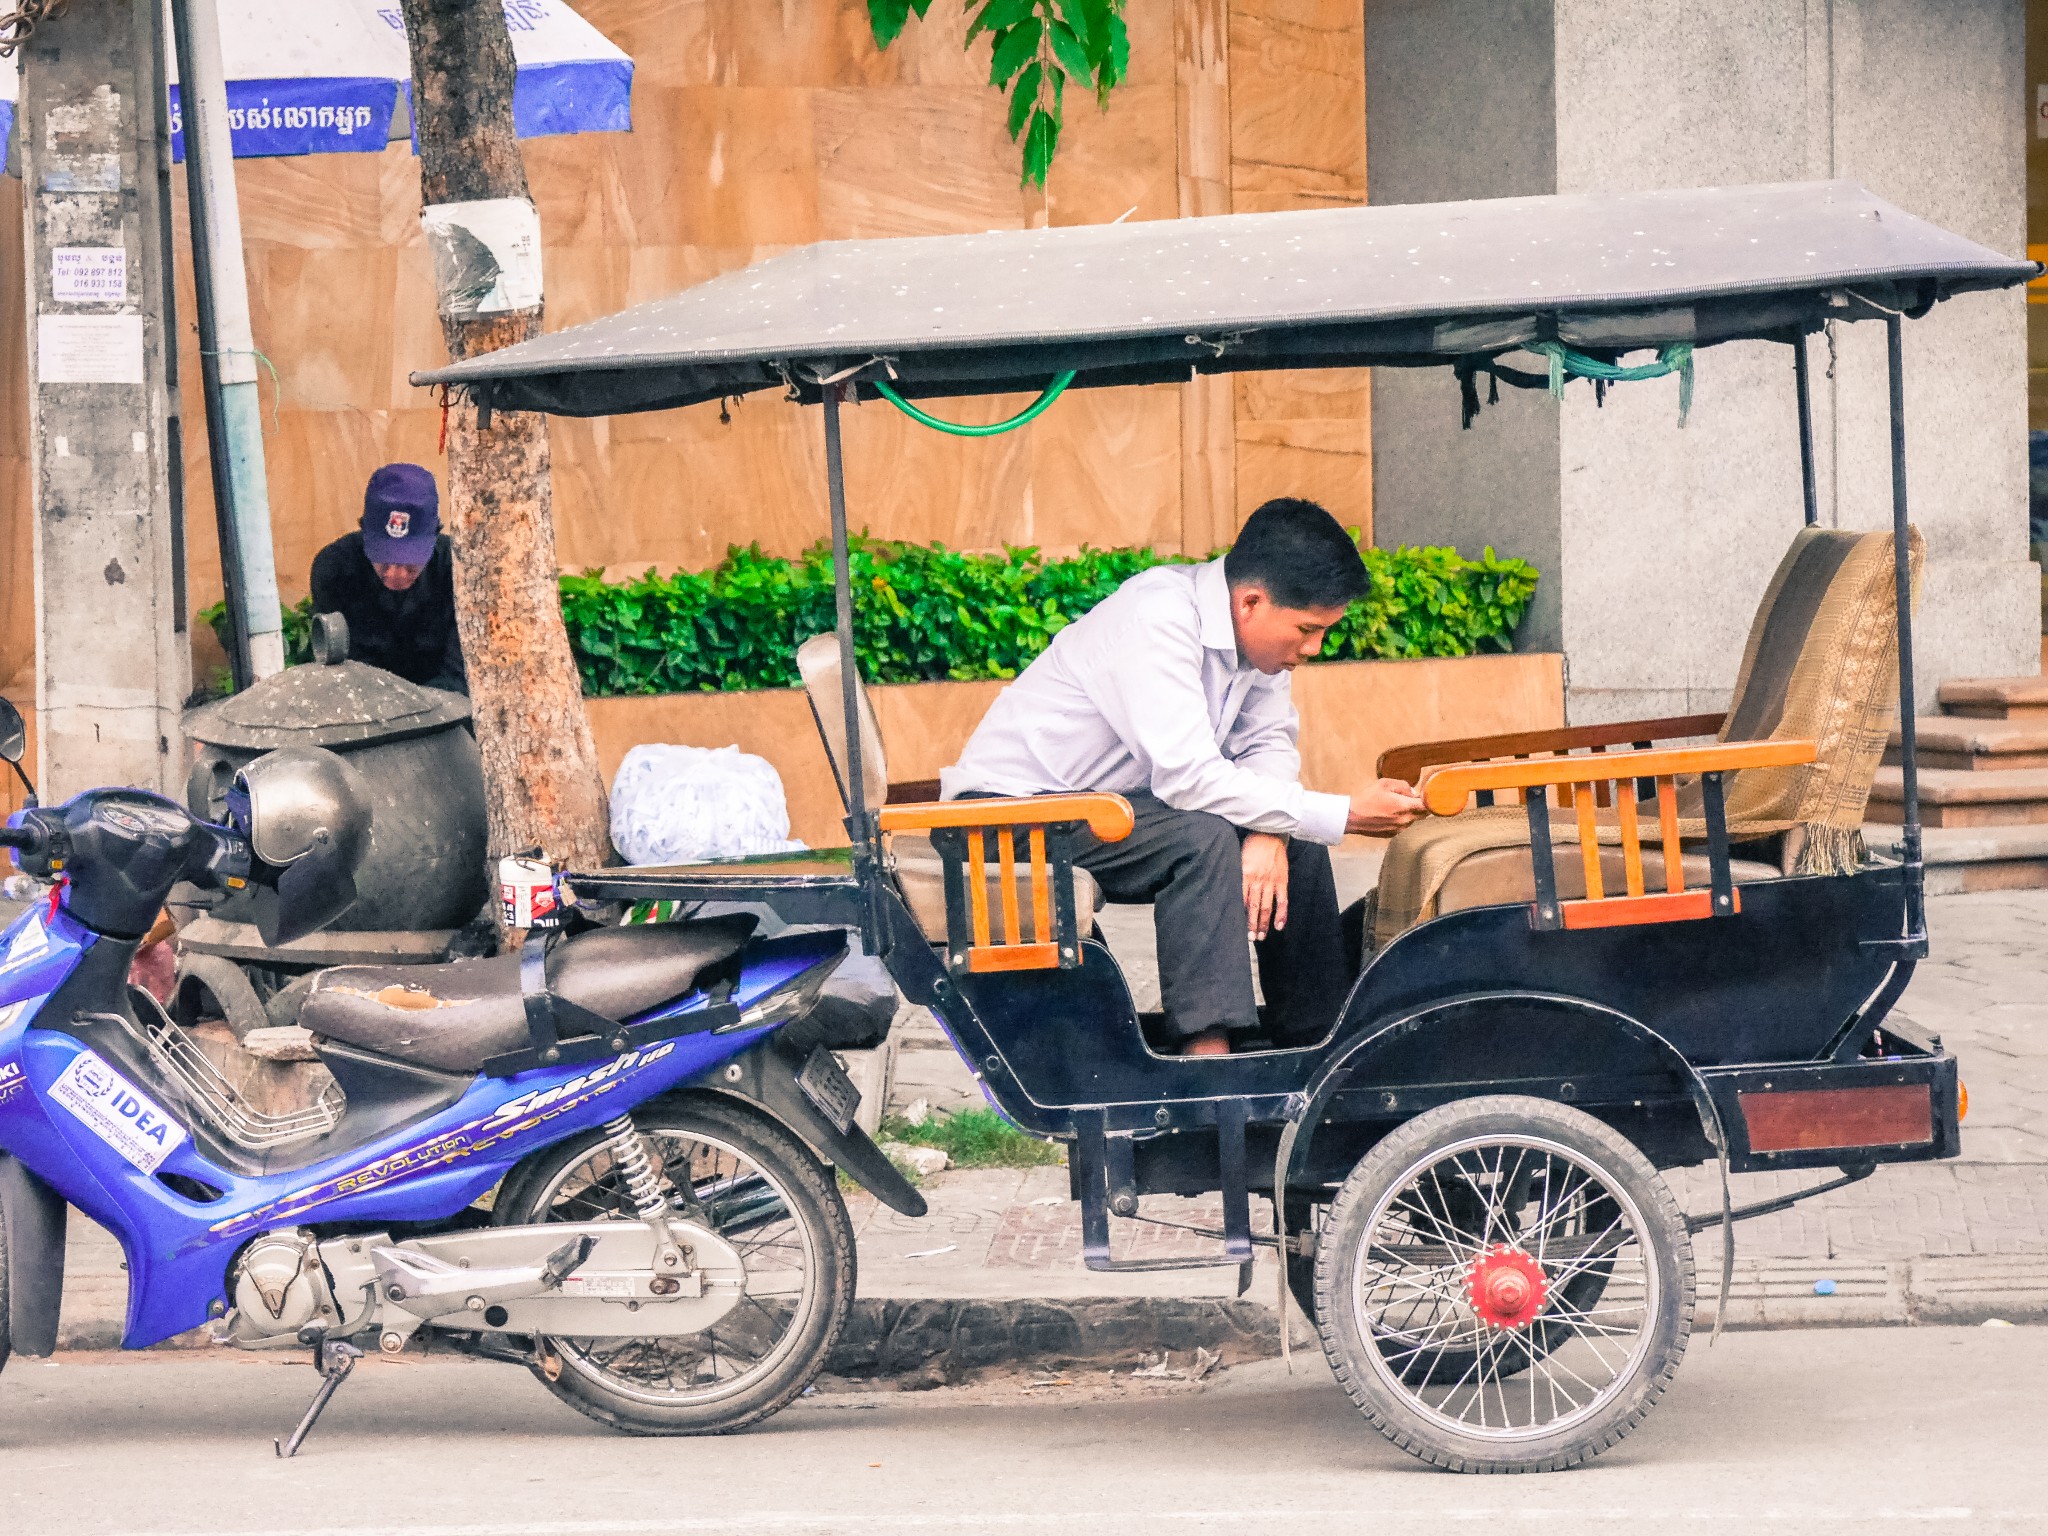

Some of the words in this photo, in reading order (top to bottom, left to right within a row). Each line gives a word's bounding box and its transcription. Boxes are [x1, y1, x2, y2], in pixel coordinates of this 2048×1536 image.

[0, 1061, 20, 1082] KI
[482, 1053, 641, 1132] Smash
[110, 1089, 168, 1146] IDEA
